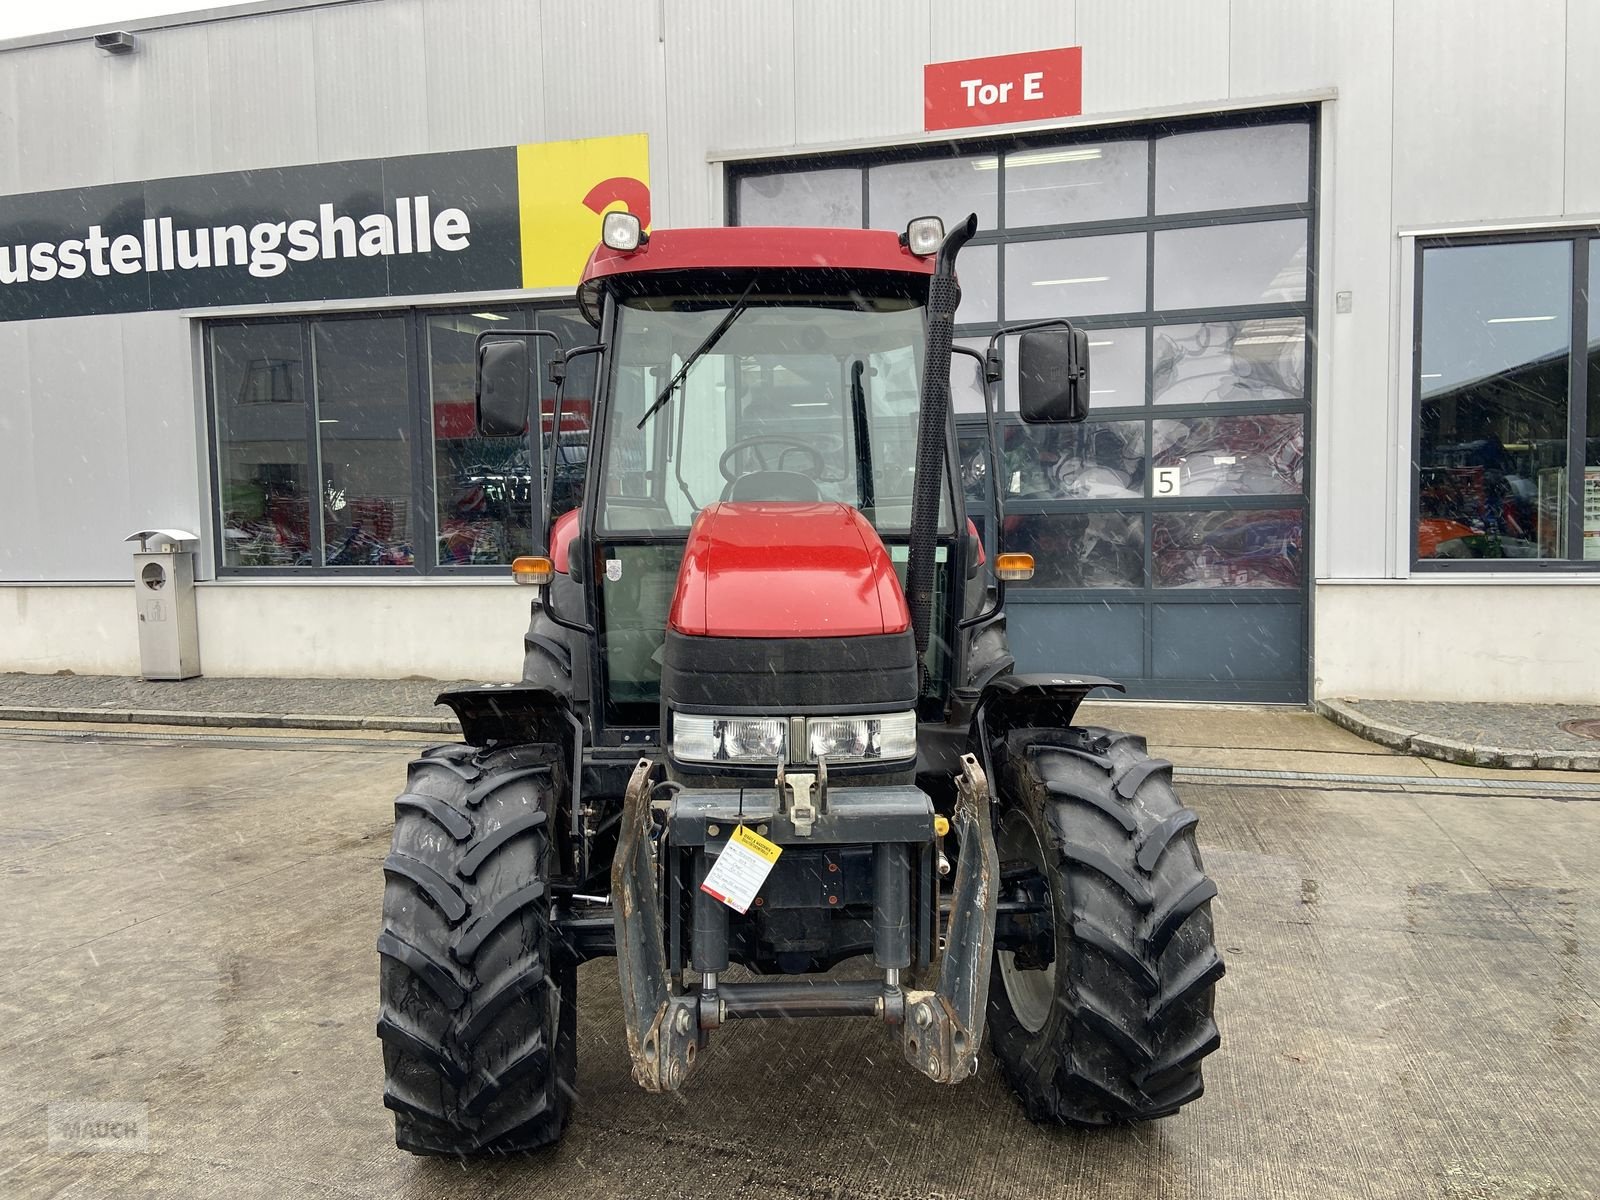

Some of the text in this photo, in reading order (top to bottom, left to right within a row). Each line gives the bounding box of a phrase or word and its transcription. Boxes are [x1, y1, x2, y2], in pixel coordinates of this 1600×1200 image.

[960, 71, 1044, 107] Tor E
[1158, 471, 1174, 494] 5
